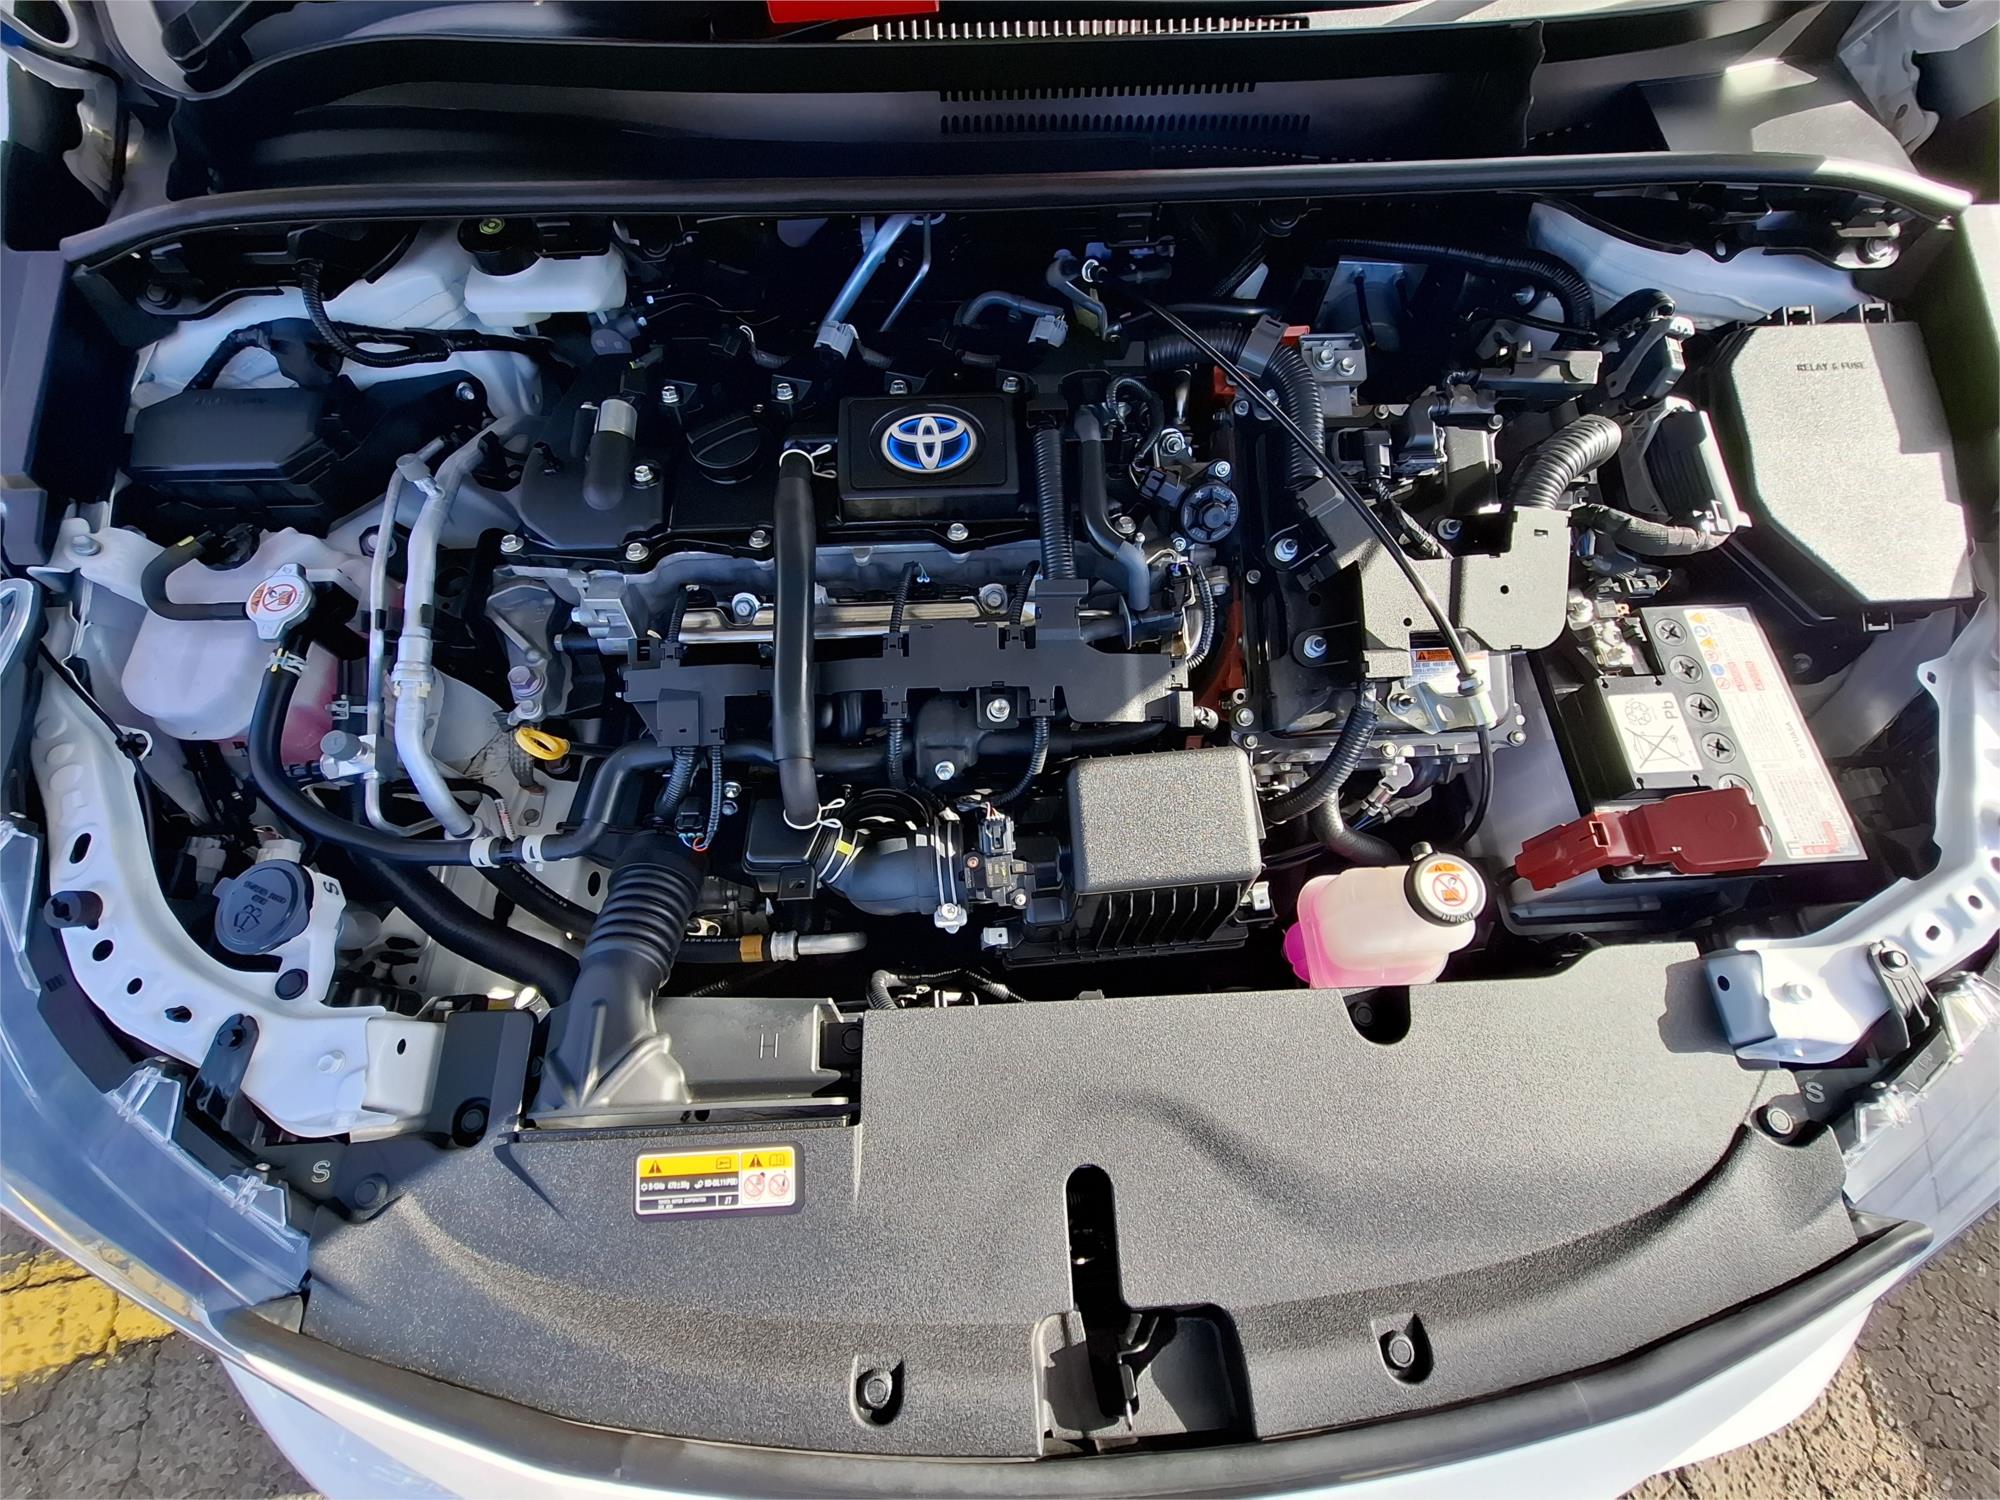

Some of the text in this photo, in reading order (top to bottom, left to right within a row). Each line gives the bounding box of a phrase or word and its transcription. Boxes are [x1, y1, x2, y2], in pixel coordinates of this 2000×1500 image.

[1796, 363, 1828, 371] RELAY
[1662, 700, 1679, 719] Pb
[323, 881, 340, 896] S
[1804, 1081, 1825, 1103] S
[311, 1160, 331, 1183] S
